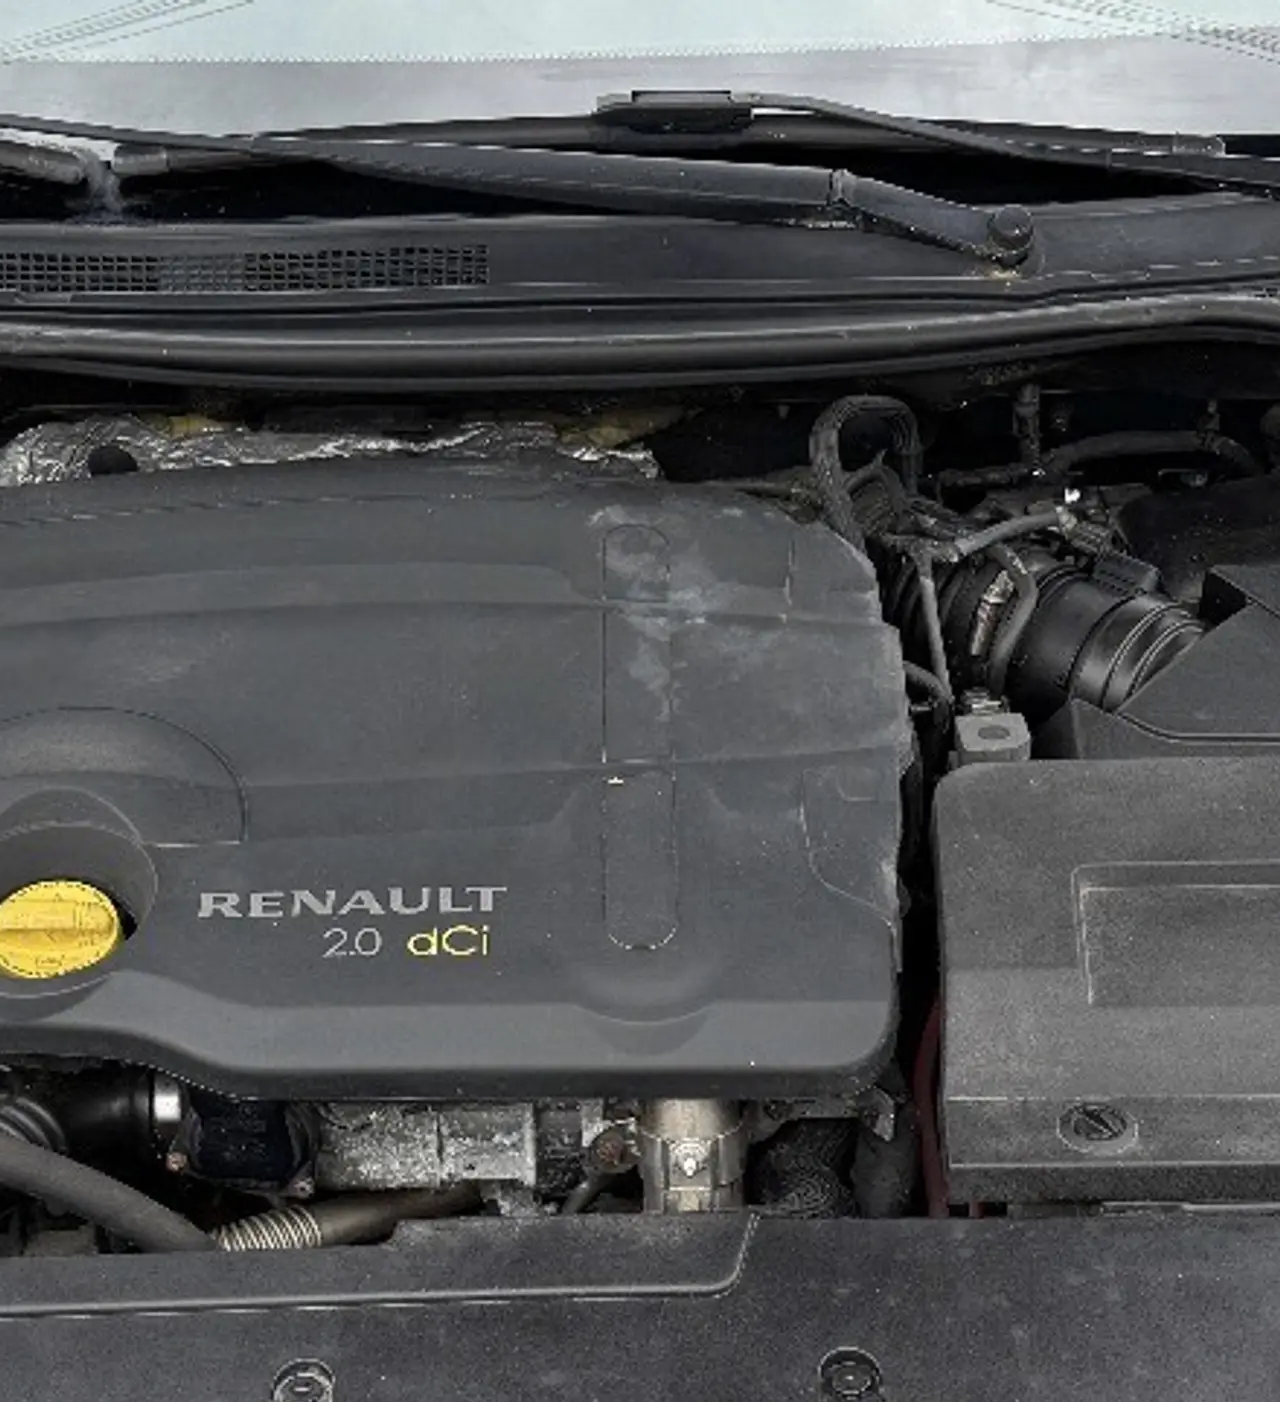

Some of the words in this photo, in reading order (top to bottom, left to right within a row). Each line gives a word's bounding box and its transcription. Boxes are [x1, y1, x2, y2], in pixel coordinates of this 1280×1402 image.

[197, 886, 508, 918] RENAULT
[322, 926, 383, 958] 2.0
[406, 924, 491, 956] dCi
